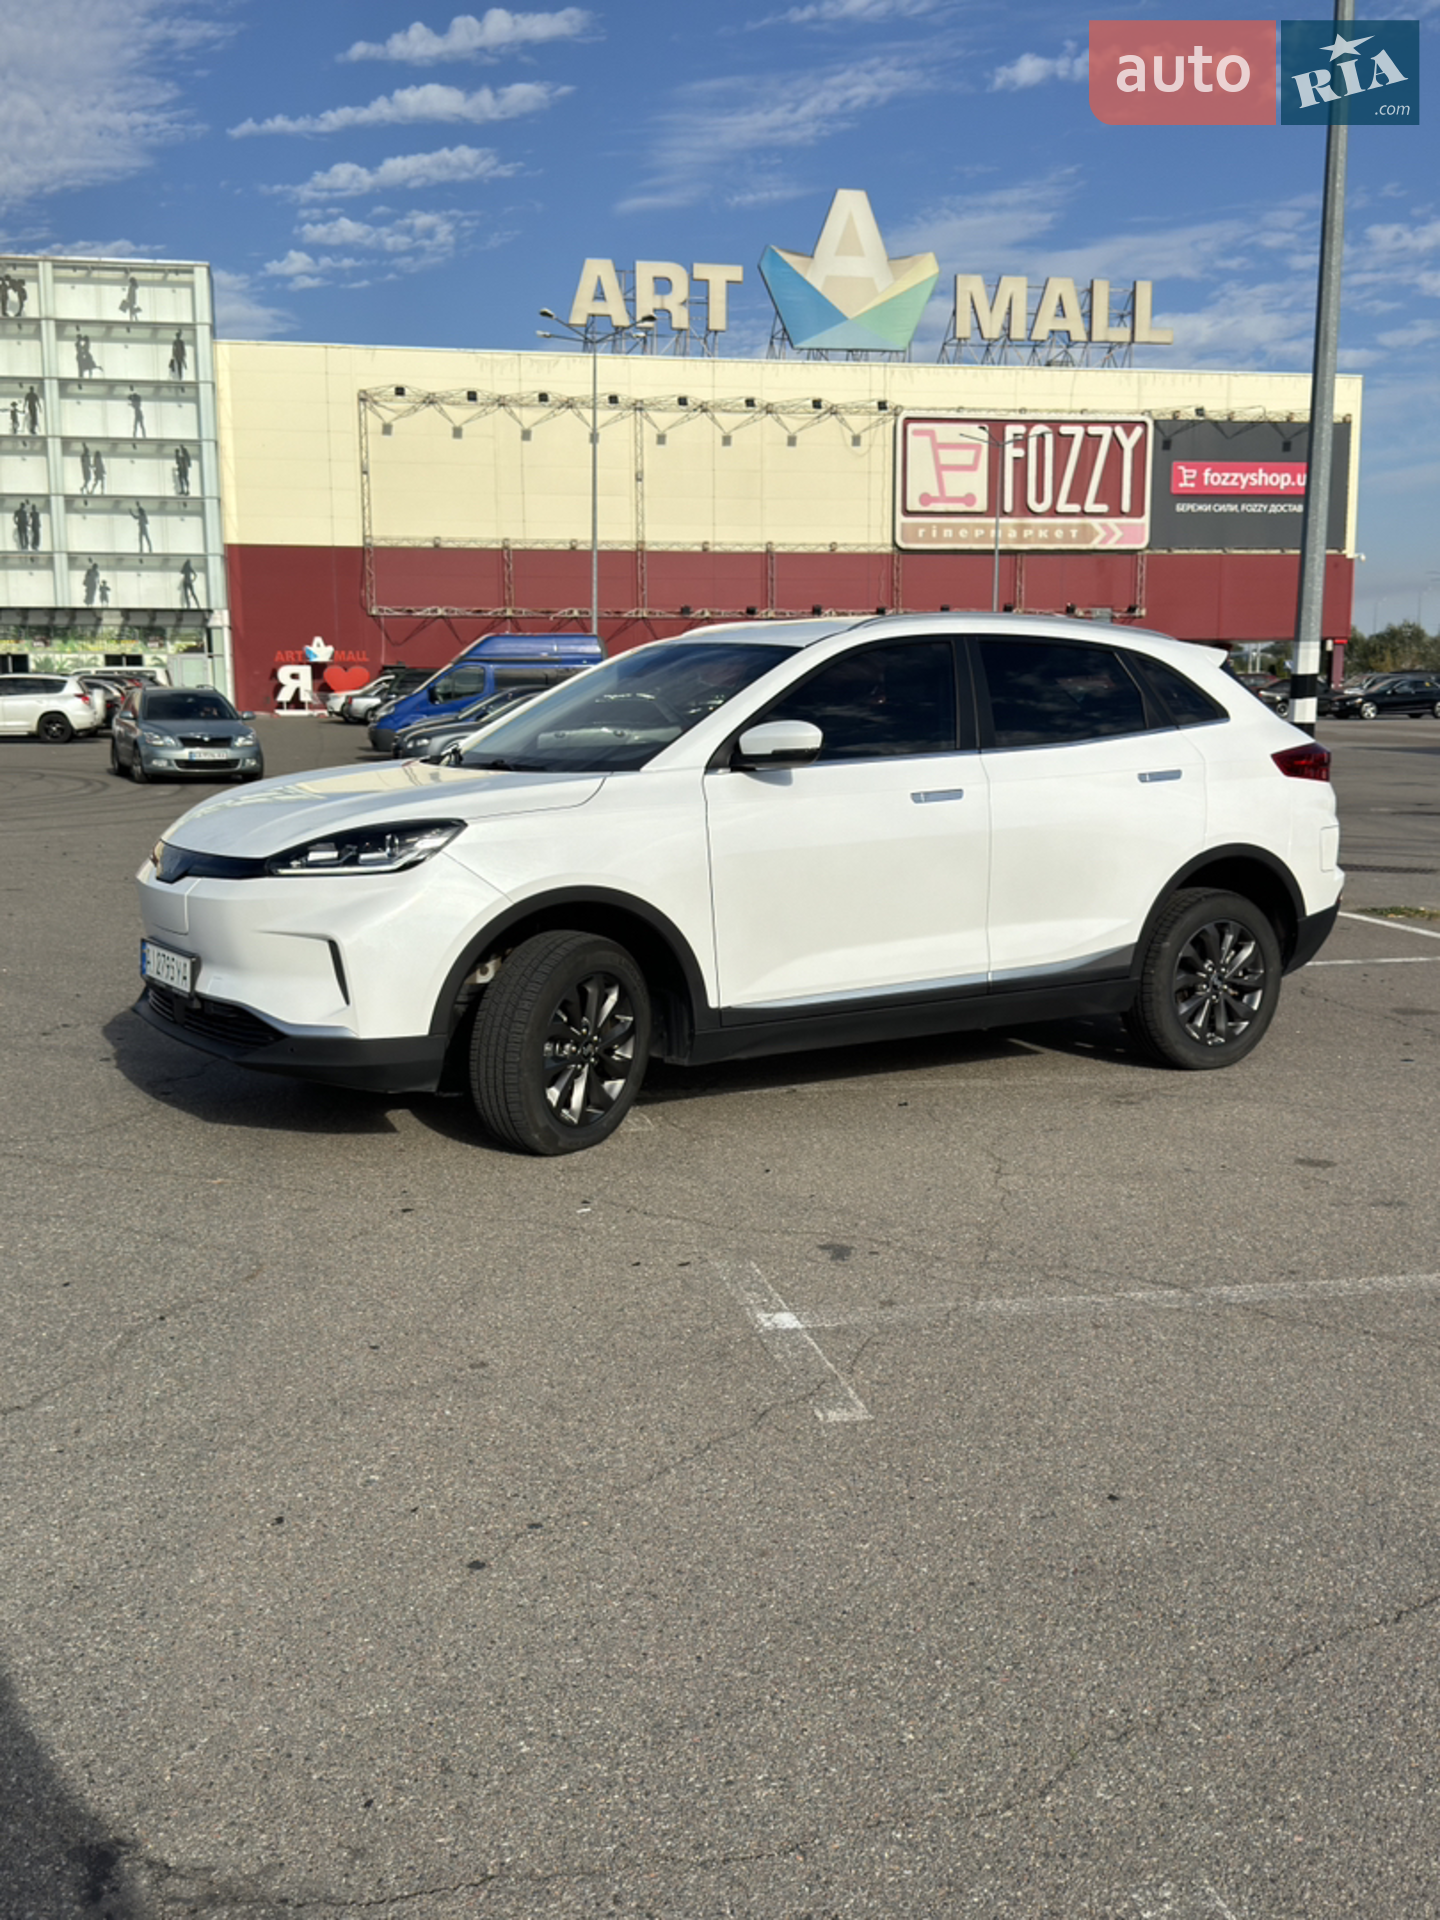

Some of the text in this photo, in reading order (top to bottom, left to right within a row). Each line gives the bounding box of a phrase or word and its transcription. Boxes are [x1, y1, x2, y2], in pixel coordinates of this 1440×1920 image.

[568, 257, 744, 331] ART
[954, 273, 1175, 345] MALL
[1004, 424, 1143, 513] FOZZY
[1202, 467, 1307, 490] fozzyshop.u
[1241, 503, 1267, 513] FOZZY
[1268, 503, 1304, 514] ДОСТАВ
[274, 650, 303, 662] ART
[333, 650, 370, 662] MALL
[276, 664, 313, 702] Я
